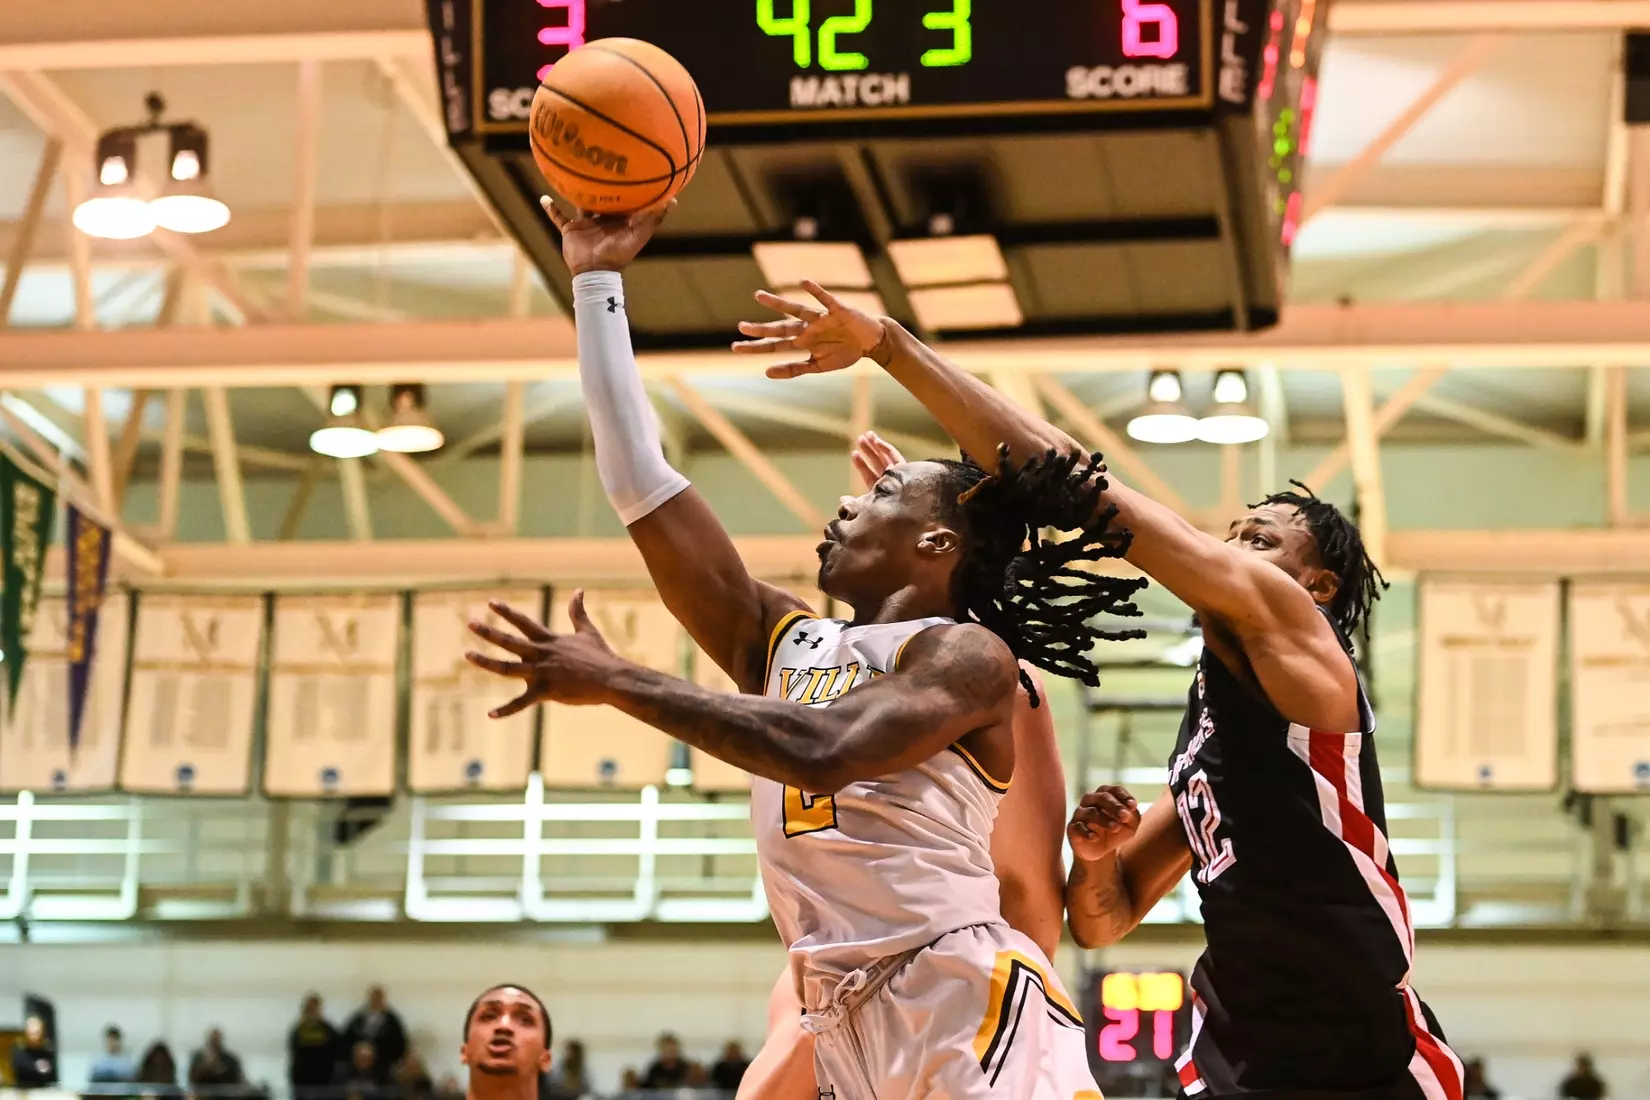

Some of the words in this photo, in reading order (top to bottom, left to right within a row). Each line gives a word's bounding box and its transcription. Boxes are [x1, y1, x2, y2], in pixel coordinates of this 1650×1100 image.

[790, 74, 910, 107] MATCH
[1065, 64, 1188, 98] SCORE
[535, 101, 628, 176] Wilson
[779, 661, 886, 705] VILL
[1176, 769, 1237, 886] 12
